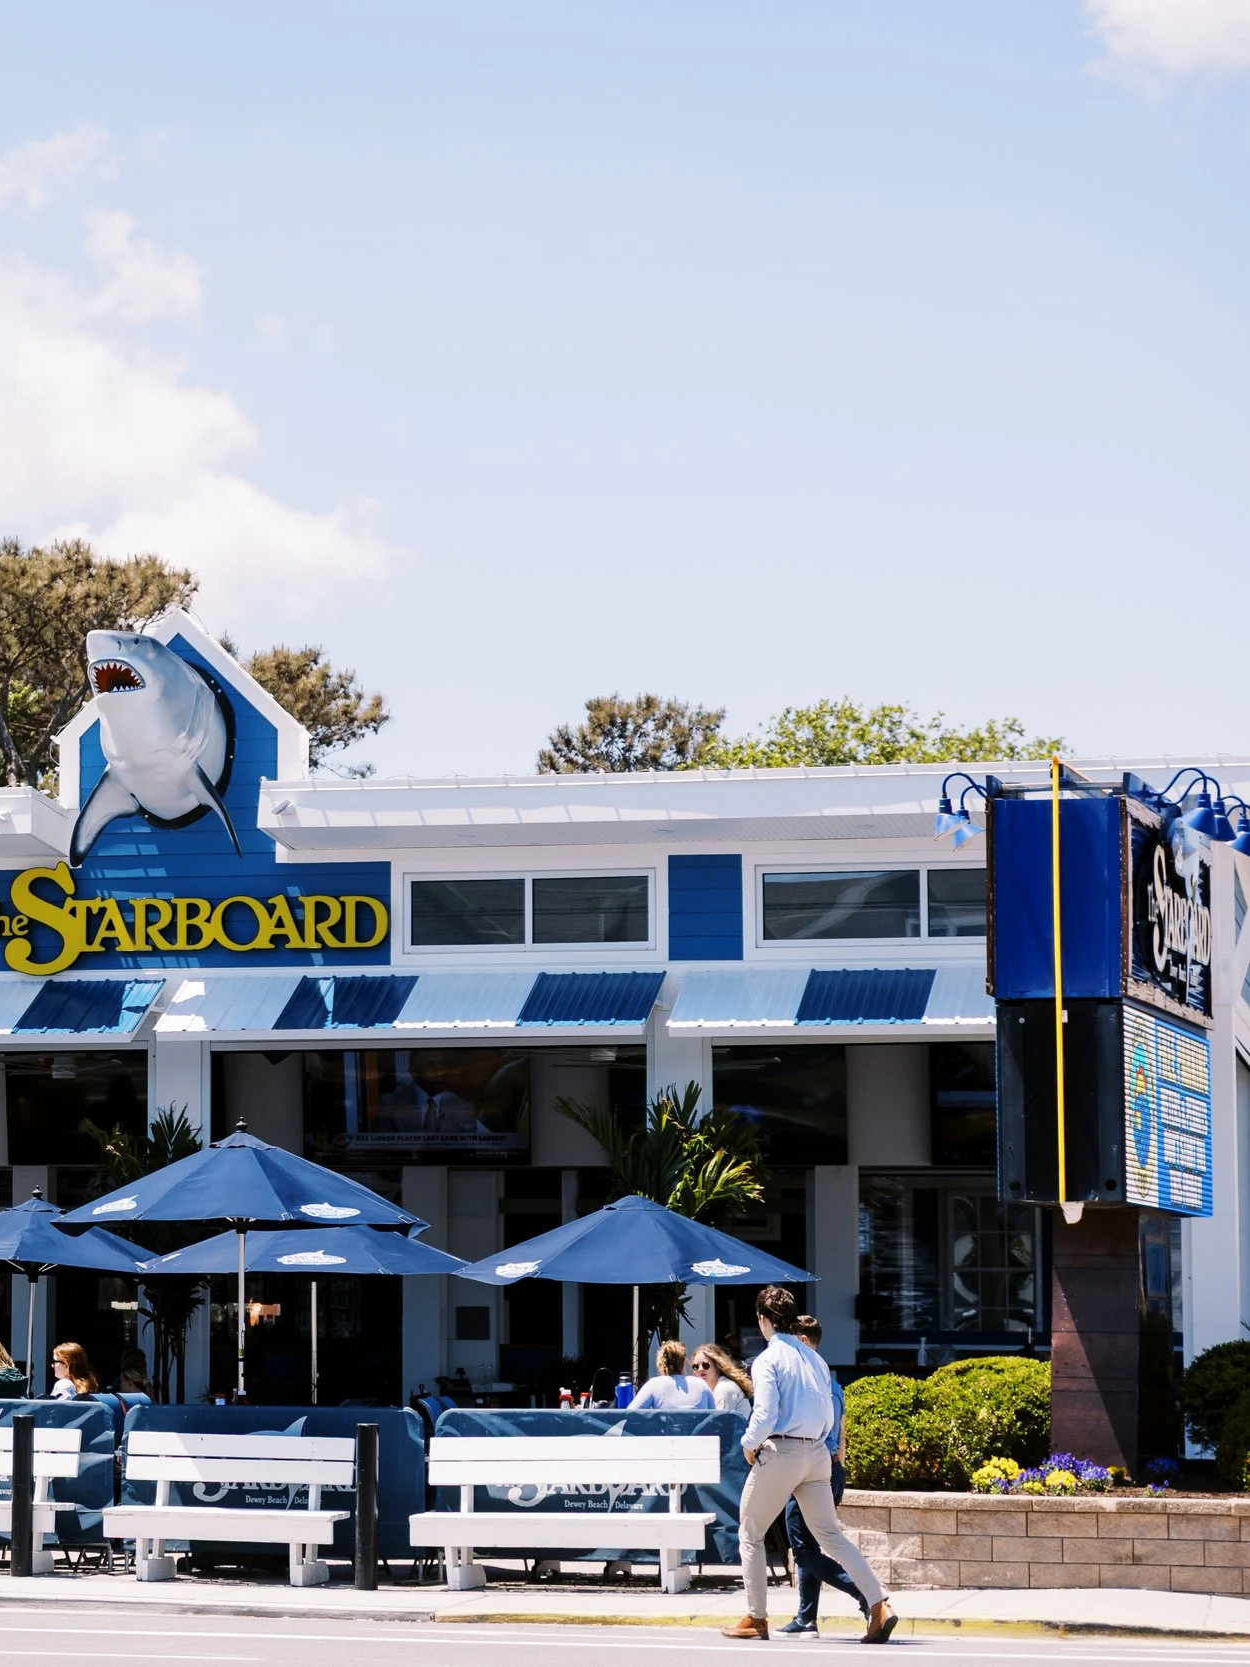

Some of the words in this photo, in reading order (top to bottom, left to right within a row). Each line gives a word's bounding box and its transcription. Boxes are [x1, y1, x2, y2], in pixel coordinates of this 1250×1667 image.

[4, 860, 389, 976] STARBOARD
[1153, 845, 1211, 972] STARBOARD
[245, 1495, 266, 1505] Dewey
[267, 1495, 288, 1504] Beach
[564, 1500, 586, 1510] Dewey
[587, 1500, 608, 1509] Beach
[615, 1501, 643, 1510] Delaware
